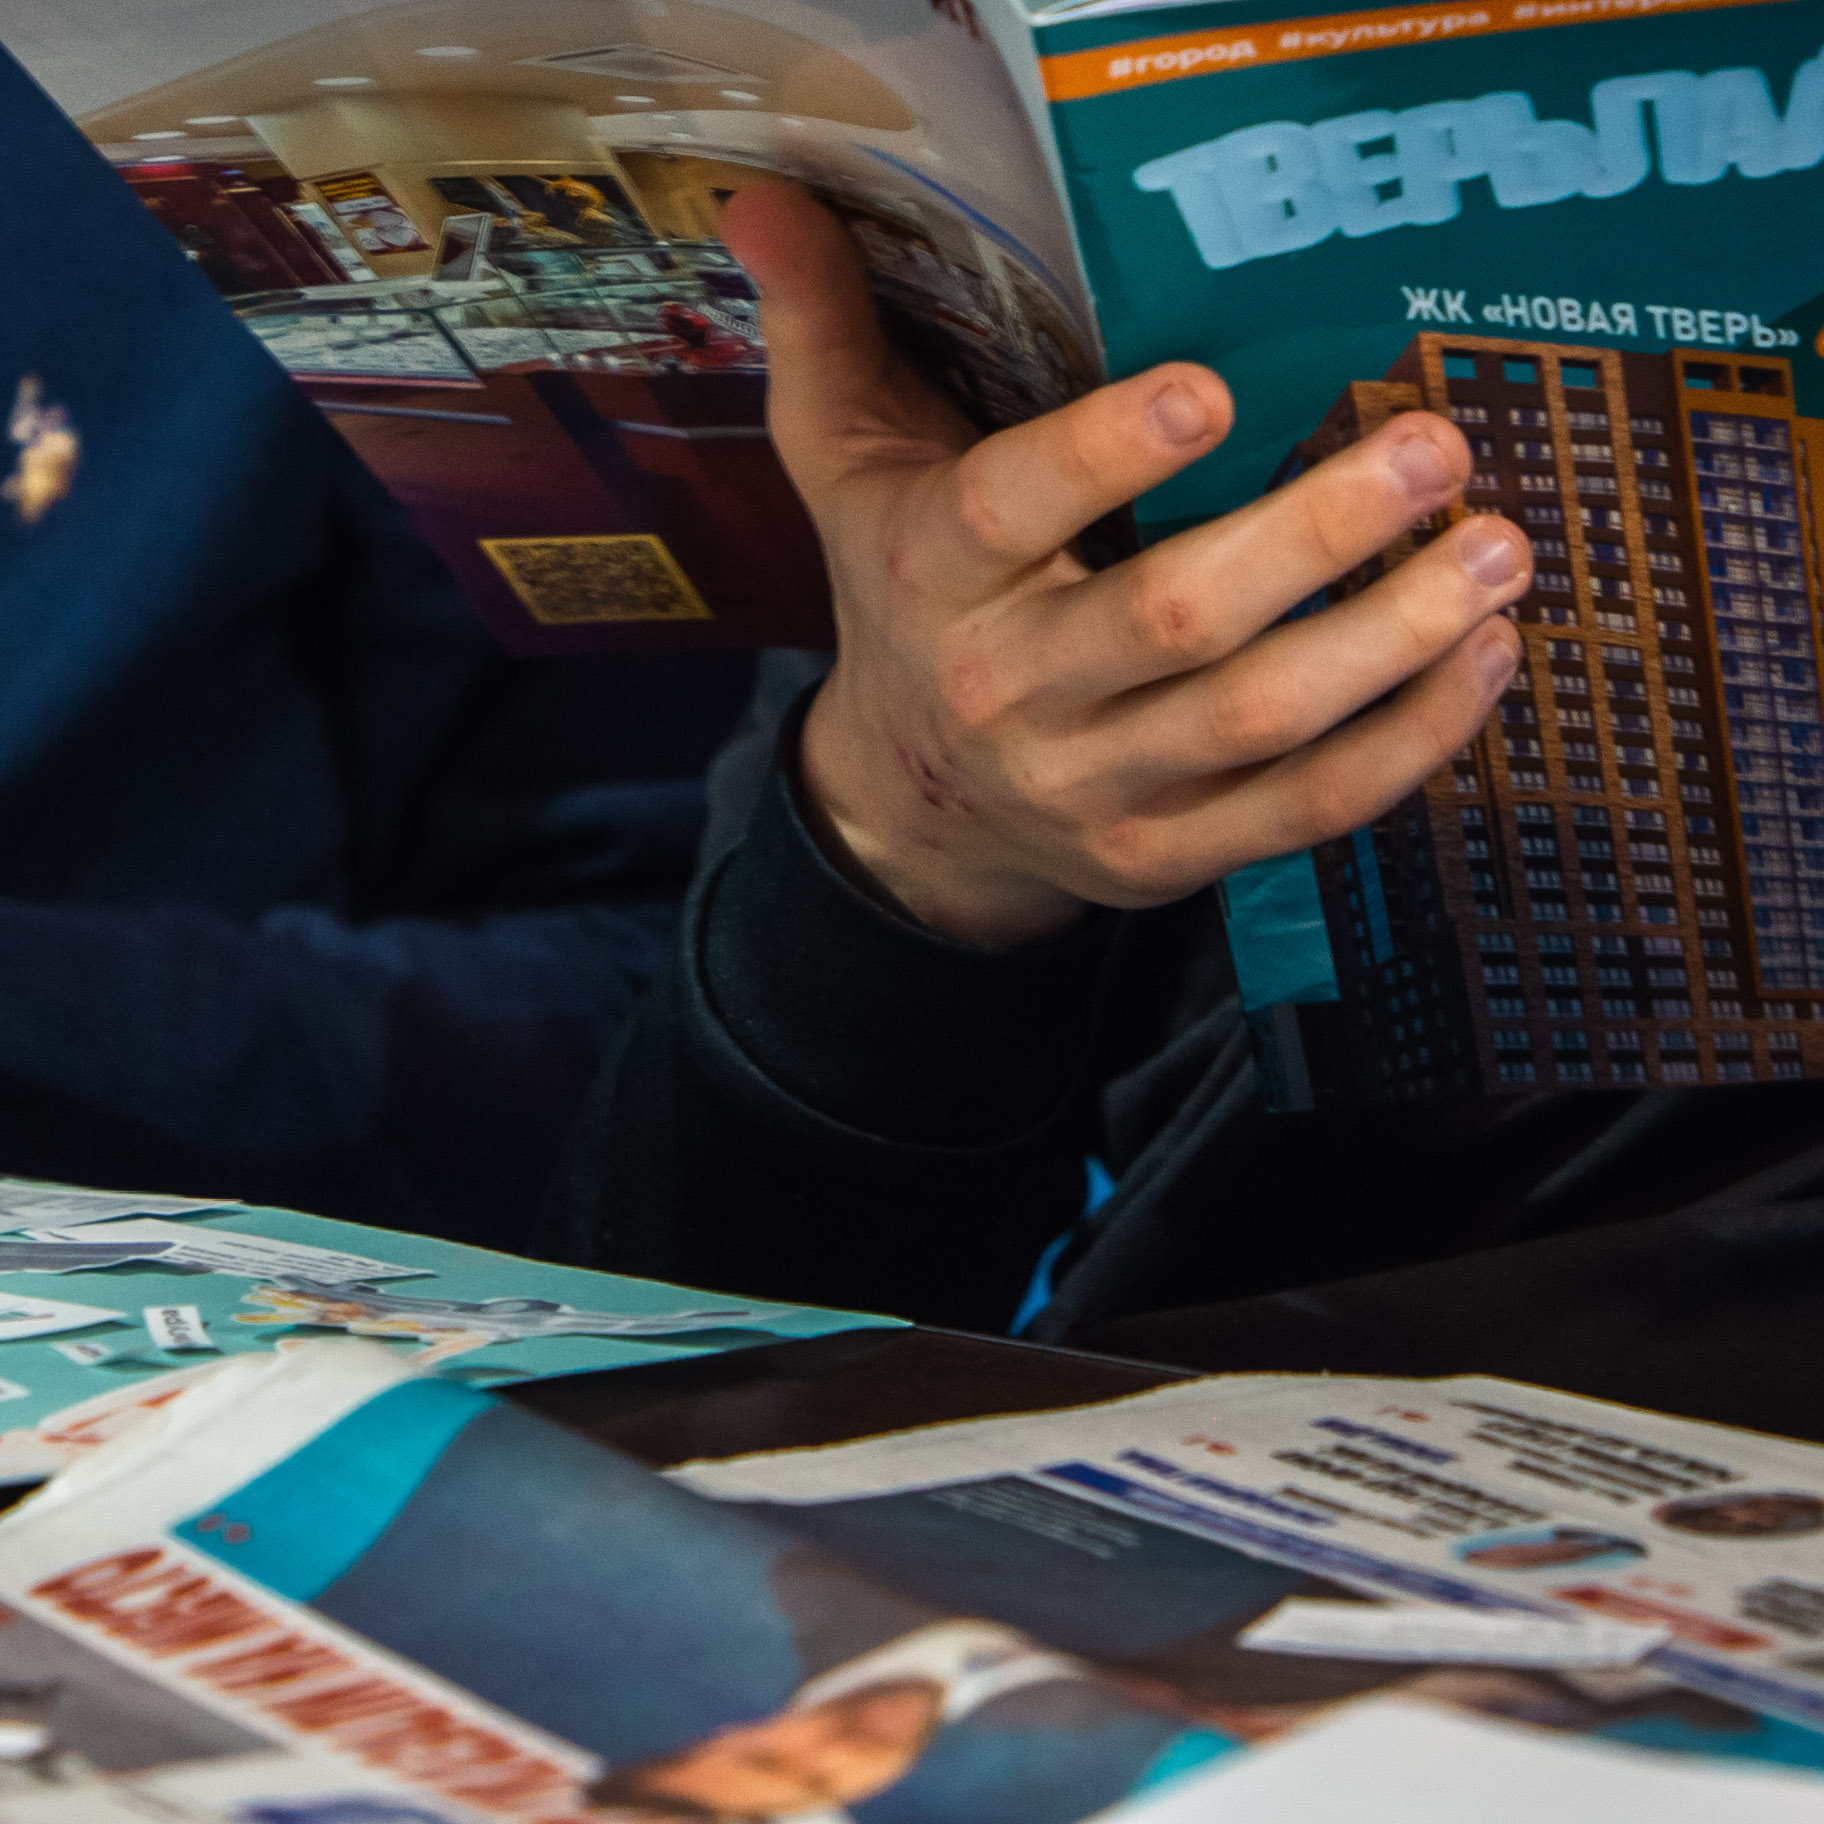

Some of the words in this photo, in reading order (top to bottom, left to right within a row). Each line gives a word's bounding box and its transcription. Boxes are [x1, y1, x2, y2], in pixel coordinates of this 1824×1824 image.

[1107, 38, 1258, 80] #город
[1279, 8, 1491, 53] #культура
[1400, 285, 1474, 325] ЖК
[1481, 293, 1639, 337] «НОВАЯ
[1645, 304, 1801, 349] ТВЕРЬ»
